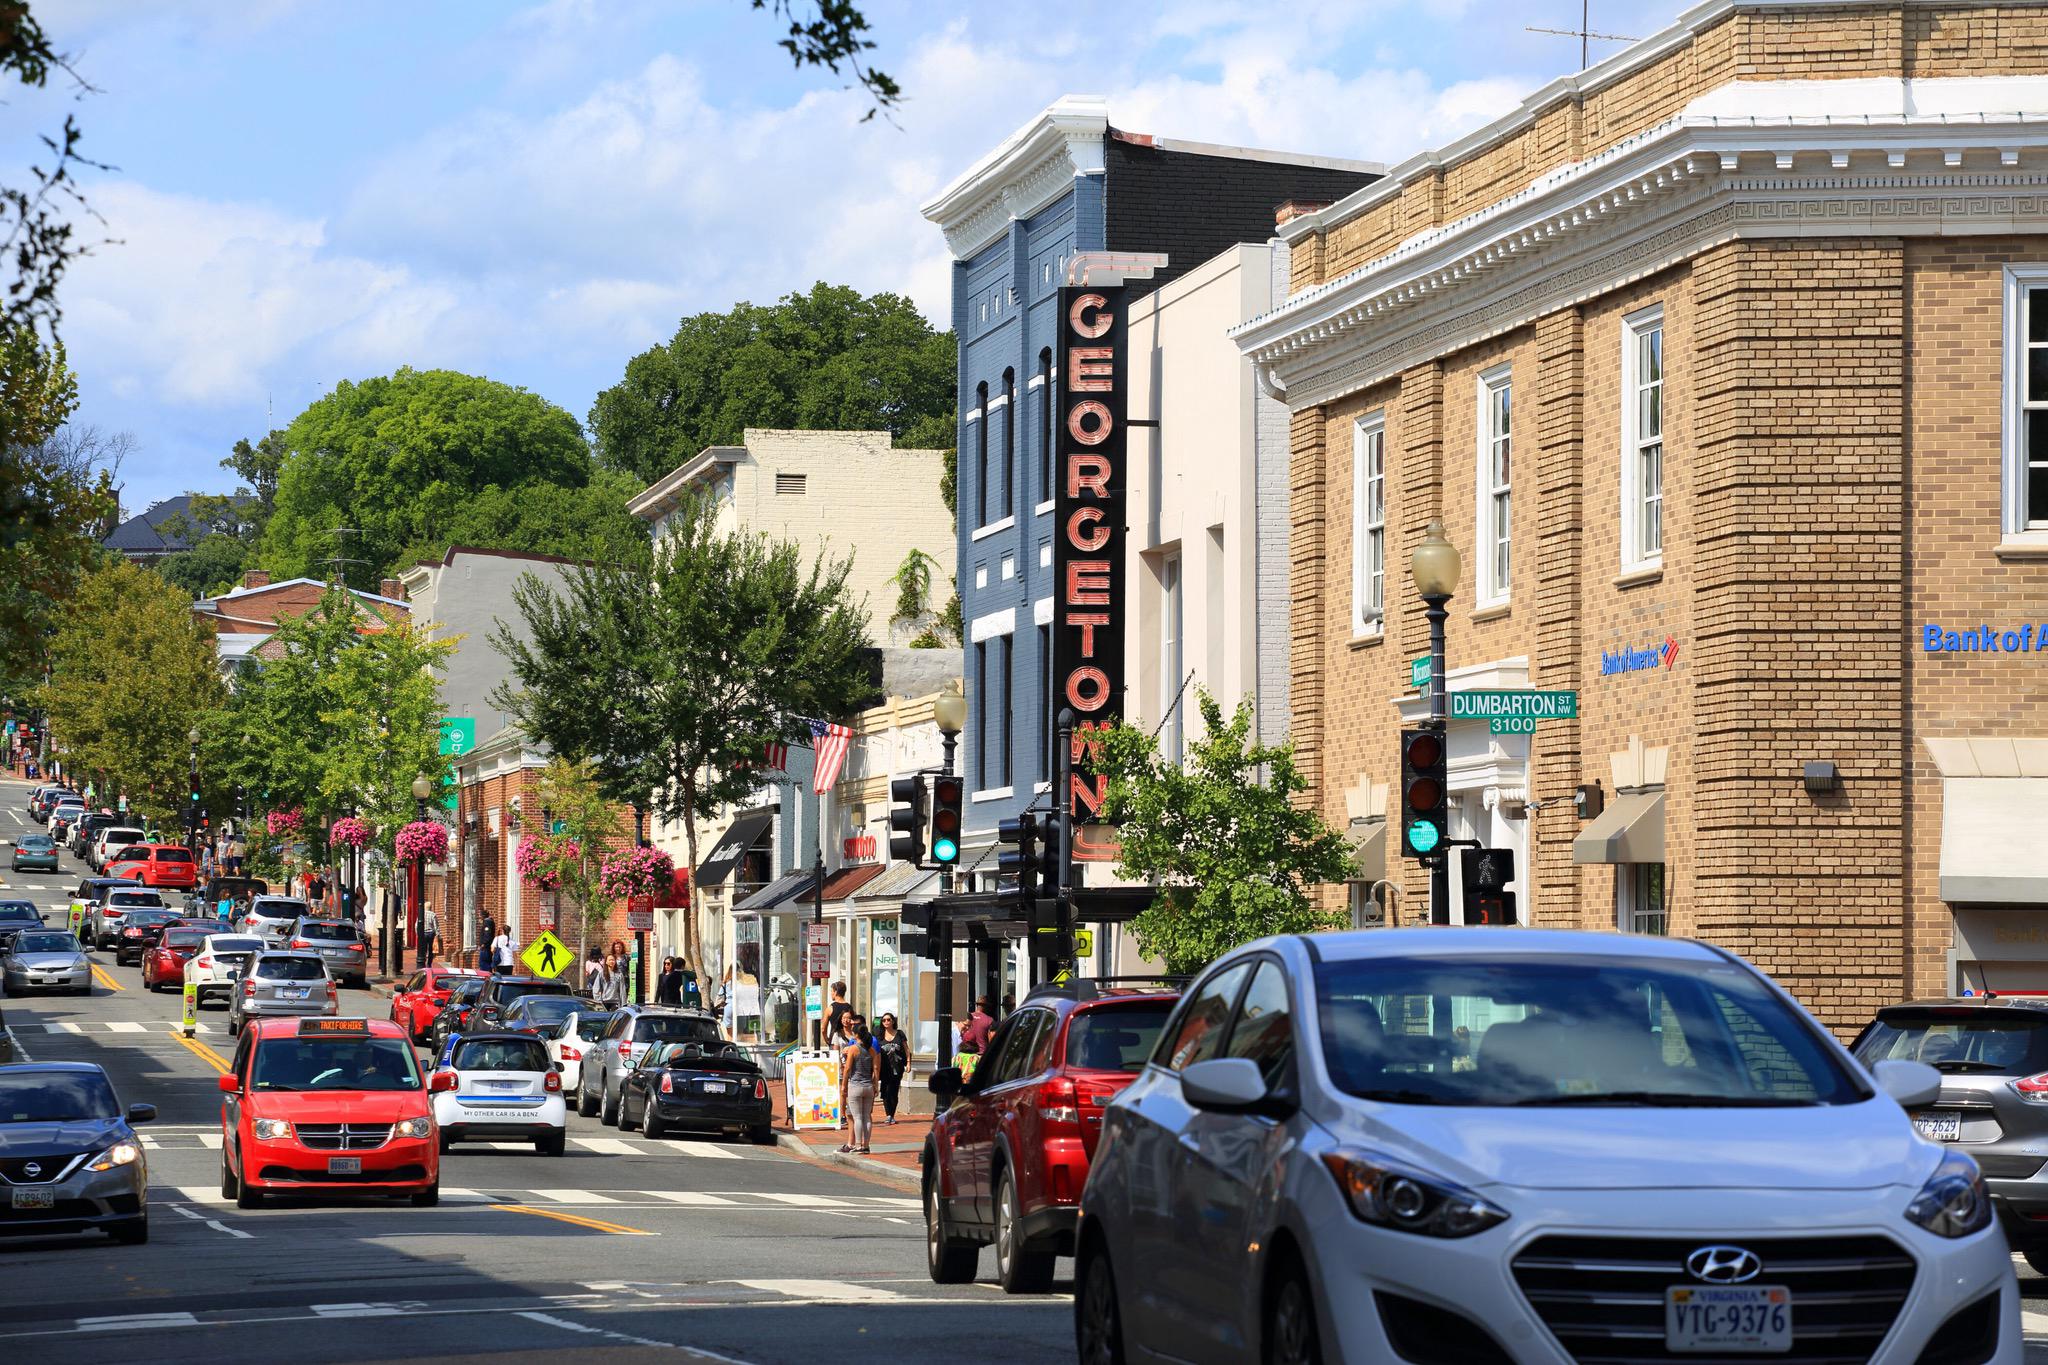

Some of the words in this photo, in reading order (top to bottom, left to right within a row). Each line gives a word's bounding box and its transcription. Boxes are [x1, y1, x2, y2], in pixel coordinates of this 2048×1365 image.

[1066, 293, 1114, 817] GEORGETOWN
[1923, 624, 1999, 652] Bank
[2002, 624, 2032, 652] of
[1602, 650, 1620, 675] Bank
[1629, 643, 1658, 672] America
[1454, 695, 1555, 715] DUMBARTON
[1558, 696, 1571, 705] ST
[1558, 705, 1571, 714] NW
[1492, 718, 1534, 731] 3100
[689, 981, 696, 991] P
[1699, 1289, 1759, 1302] VIRGINIA
[1675, 1304, 1786, 1335] VTG-9376
